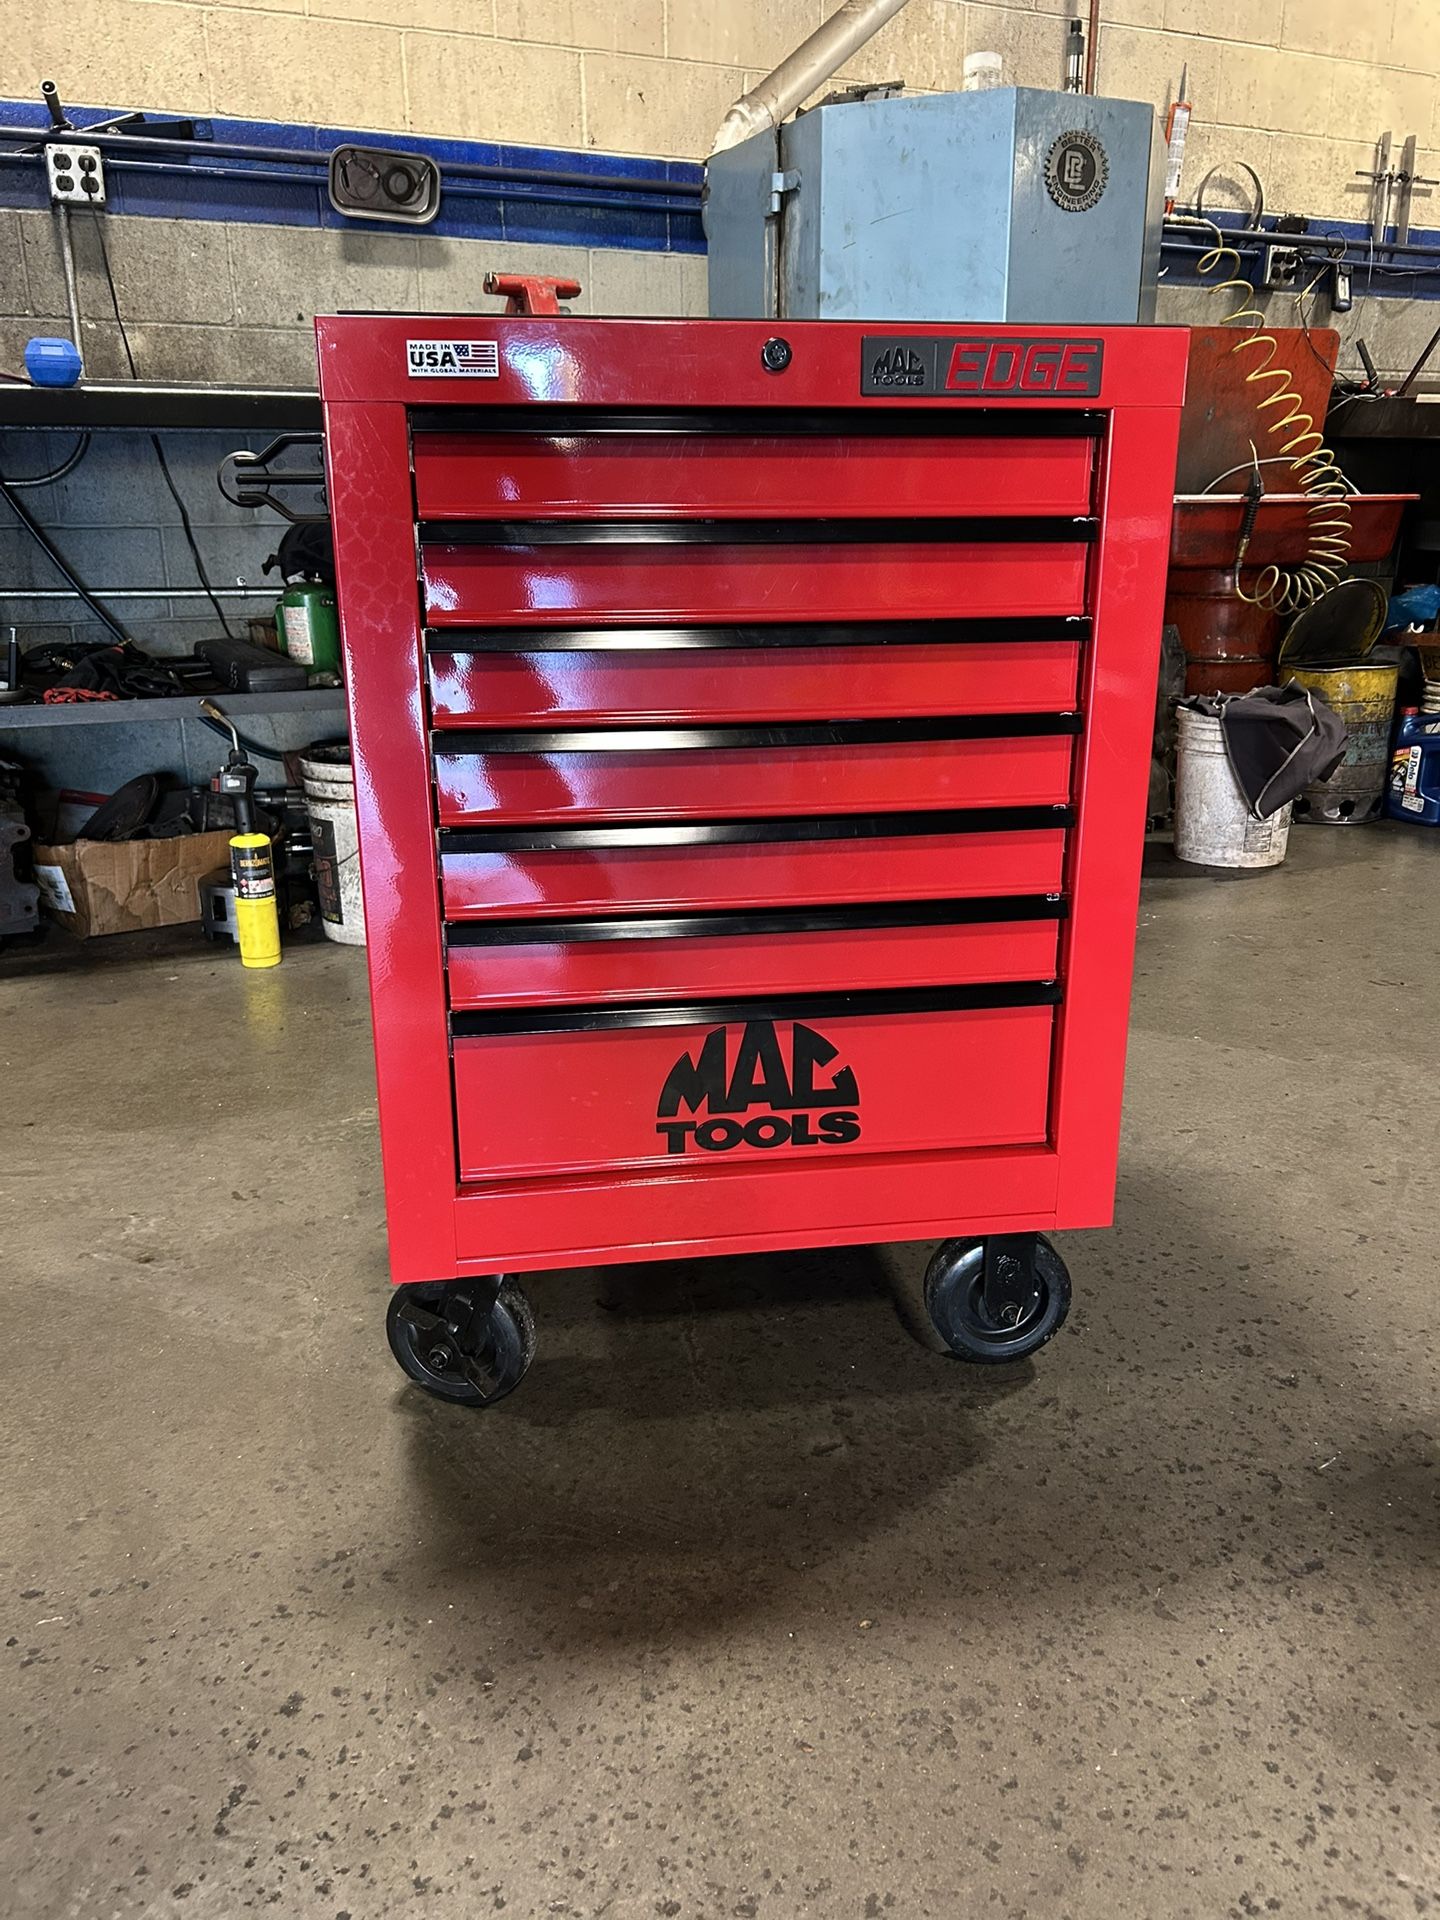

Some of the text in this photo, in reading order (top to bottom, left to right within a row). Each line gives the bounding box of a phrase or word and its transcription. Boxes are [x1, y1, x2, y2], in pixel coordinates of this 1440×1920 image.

[1061, 135, 1097, 153] BETTER
[1051, 174, 1101, 205] ENGINEERING
[409, 351, 457, 368] USA
[871, 346, 925, 375] MAC
[945, 343, 1098, 390] EDGE
[871, 375, 925, 386] TOOLS
[1408, 760, 1418, 780] Delo
[657, 1020, 860, 1118] MAC
[656, 1111, 861, 1154] TOOLS
